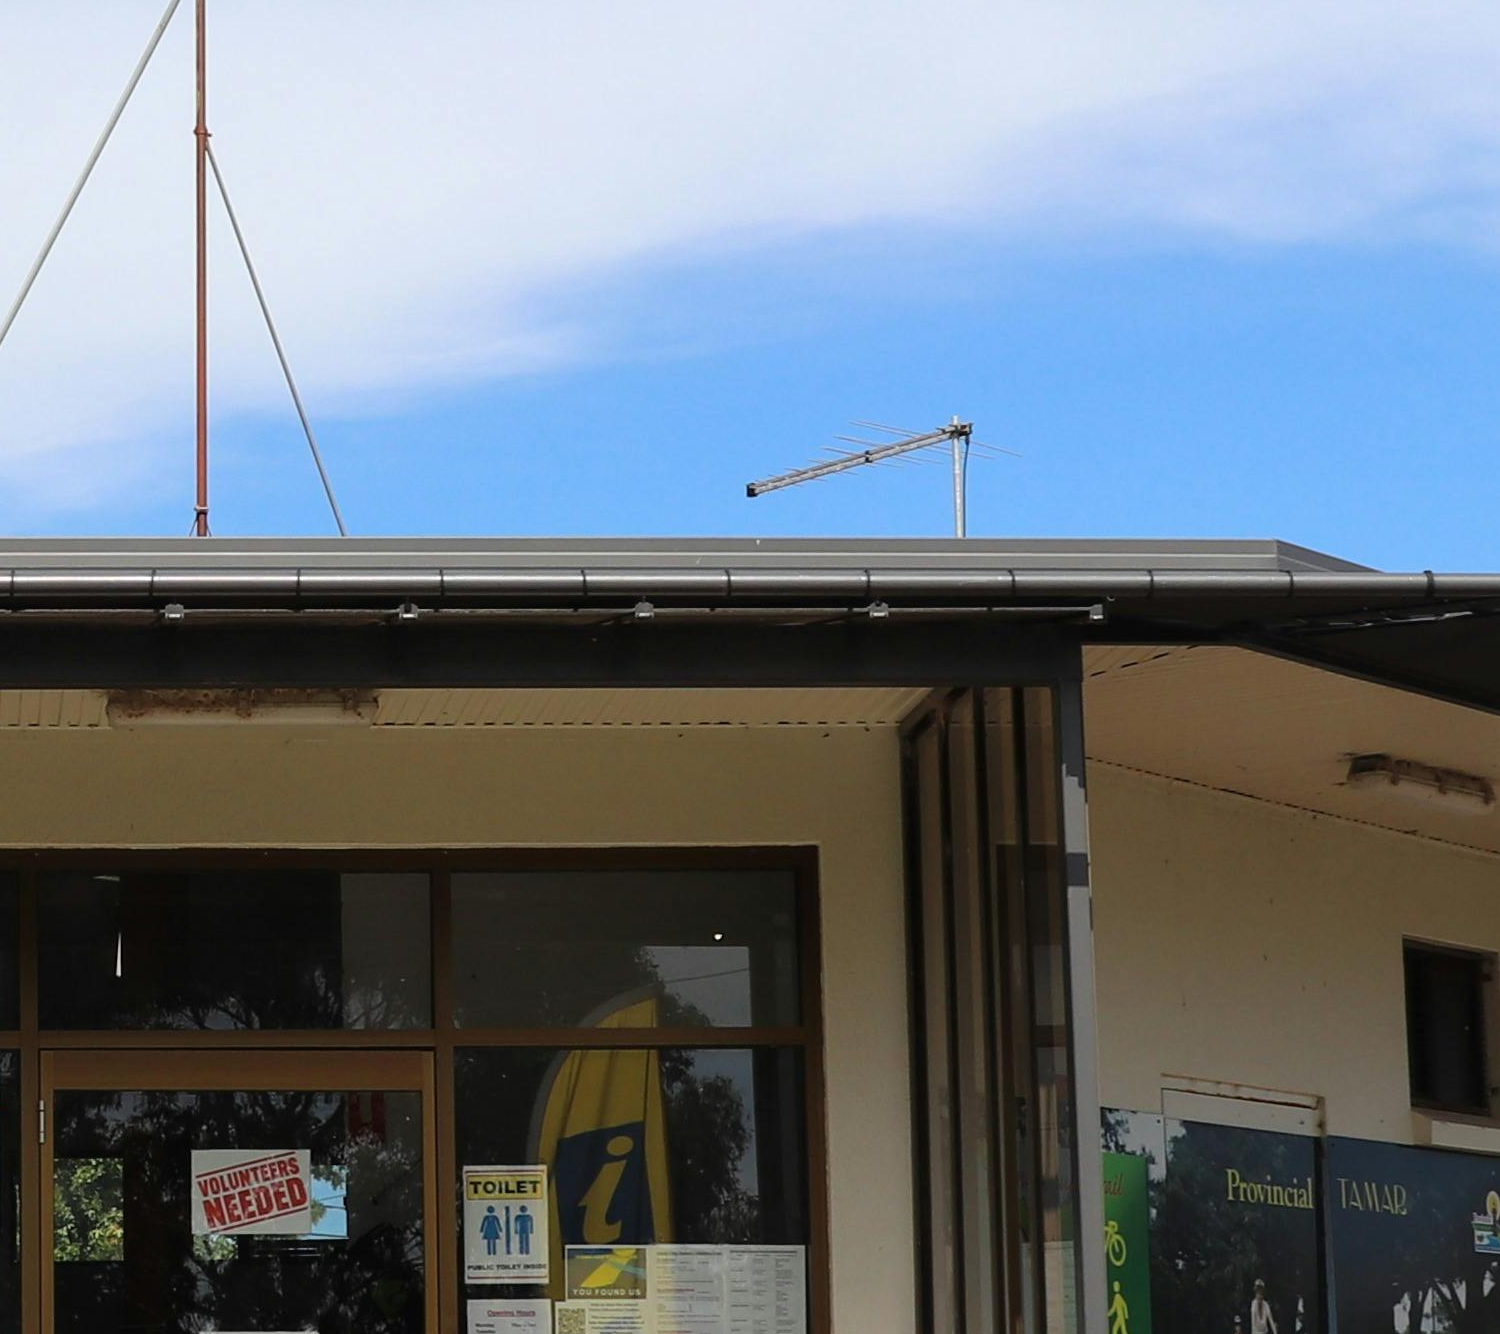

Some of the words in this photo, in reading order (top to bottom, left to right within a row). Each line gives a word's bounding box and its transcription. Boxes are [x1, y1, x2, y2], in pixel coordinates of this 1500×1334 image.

[197, 1157, 300, 1198] VOLUNTEERS
[469, 1180, 541, 1194] TOILET
[1224, 1168, 1315, 1209] Provincial
[1336, 1177, 1408, 1216] TAMAR
[203, 1176, 308, 1229] NEEDED
[488, 1310, 514, 1318] Opening
